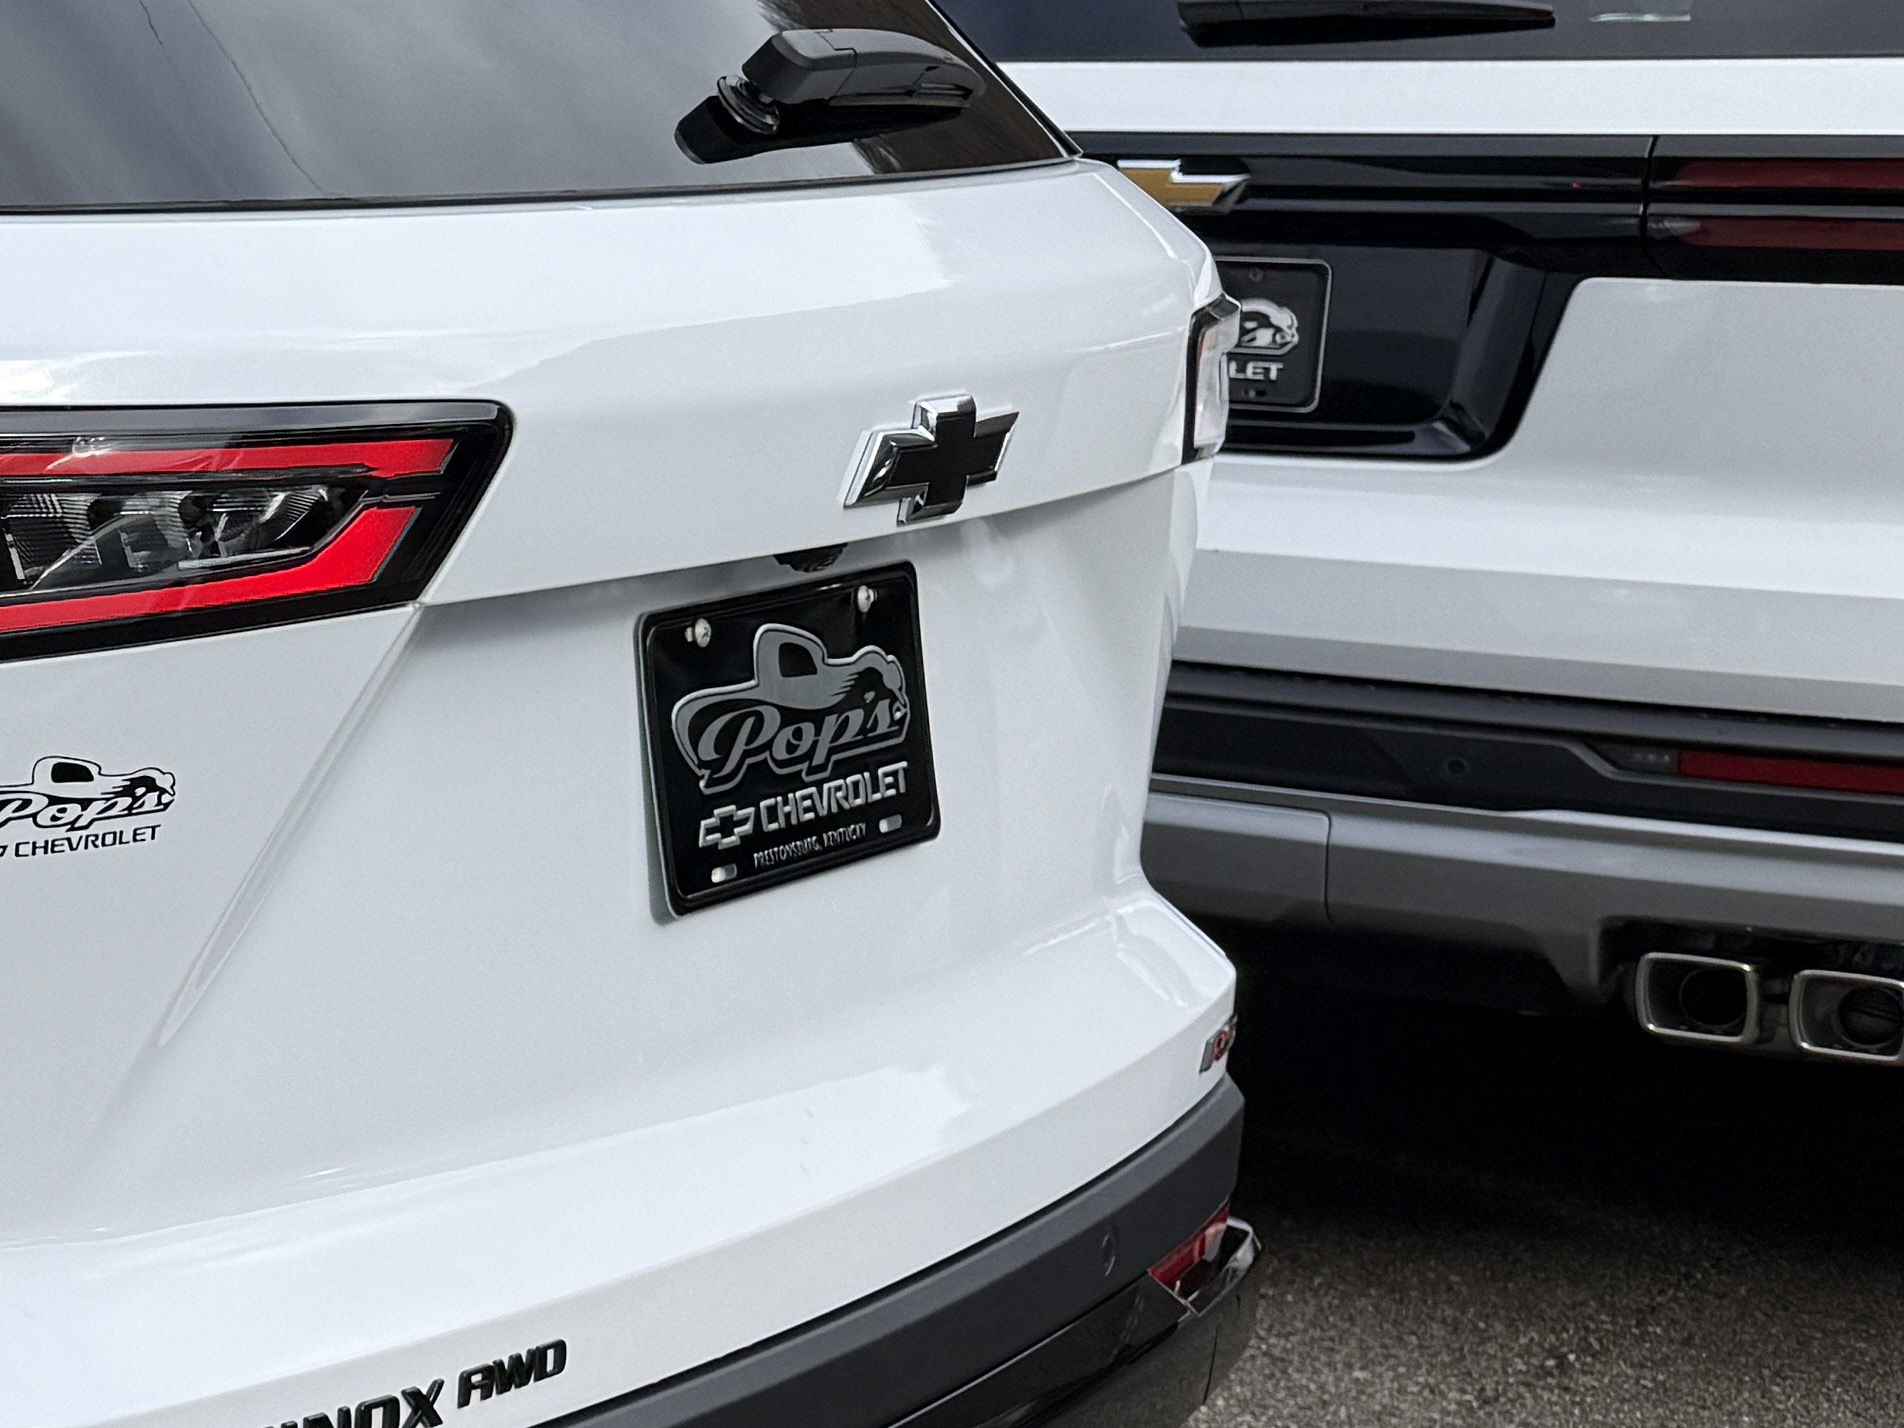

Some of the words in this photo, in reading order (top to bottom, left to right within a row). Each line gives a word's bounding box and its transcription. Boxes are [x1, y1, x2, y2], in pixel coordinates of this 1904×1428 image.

[698, 690, 904, 779] Pop's
[759, 760, 909, 832] CHEVROLET
[14, 824, 162, 858] CHEVROLET
[457, 1337, 568, 1410] AWD
